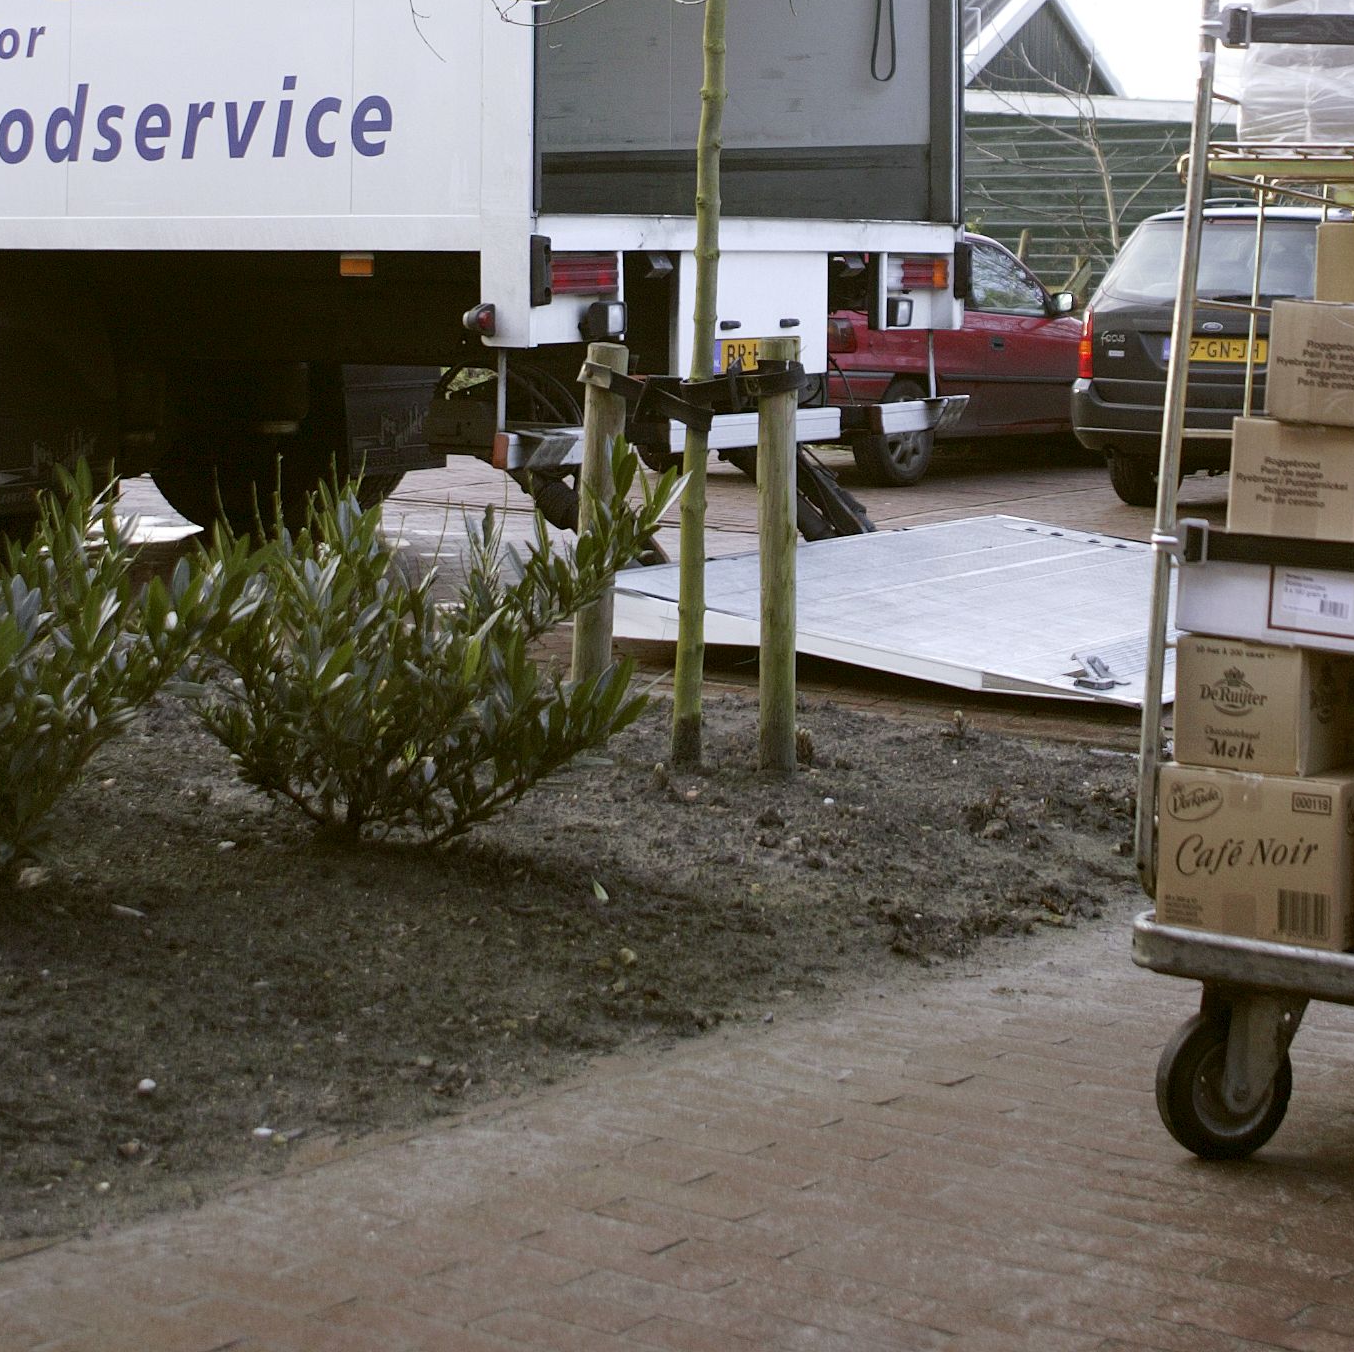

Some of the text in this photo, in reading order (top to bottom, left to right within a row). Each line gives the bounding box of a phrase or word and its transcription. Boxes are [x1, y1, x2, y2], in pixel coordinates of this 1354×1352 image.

[726, 343, 759, 368] BR-
[1188, 340, 1260, 359] 7-GN-JH
[1302, 349, 1322, 359] Pain
[1324, 350, 1337, 360] de
[1276, 356, 1321, 369] Ryebread
[1297, 377, 1315, 387] Pan
[1317, 379, 1329, 389] de
[1264, 455, 1321, 470] Roggebrood
[1260, 465, 1281, 475] Pain
[1282, 467, 1295, 477] de
[1235, 472, 1278, 485] Ryebread
[1285, 477, 1348, 491] Pumpernickel
[1263, 484, 1318, 498] Roggenbrot
[1255, 493, 1326, 509] Pan de centeno
[1207, 737, 1255, 760] Melk
[1175, 833, 1319, 876] Café Noir
